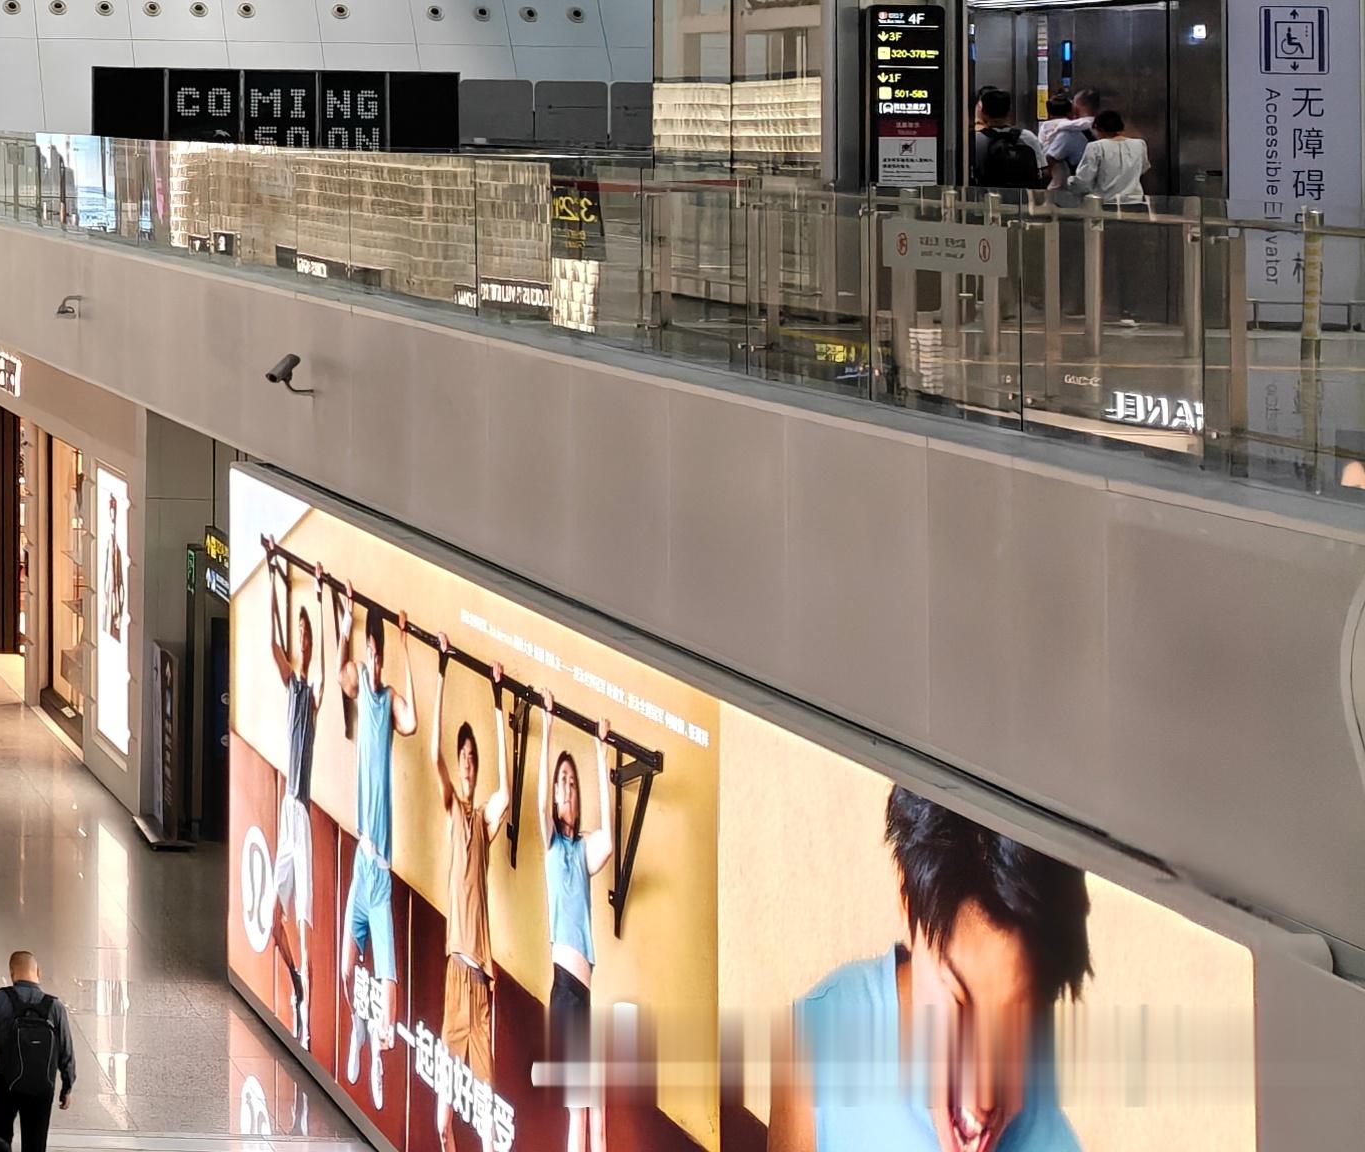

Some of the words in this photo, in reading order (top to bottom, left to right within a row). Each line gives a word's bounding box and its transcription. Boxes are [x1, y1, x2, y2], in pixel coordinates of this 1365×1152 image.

[177, 87, 379, 119] COMING
[1265, 87, 1282, 196] Accessible
[1264, 201, 1283, 285] Elvator
